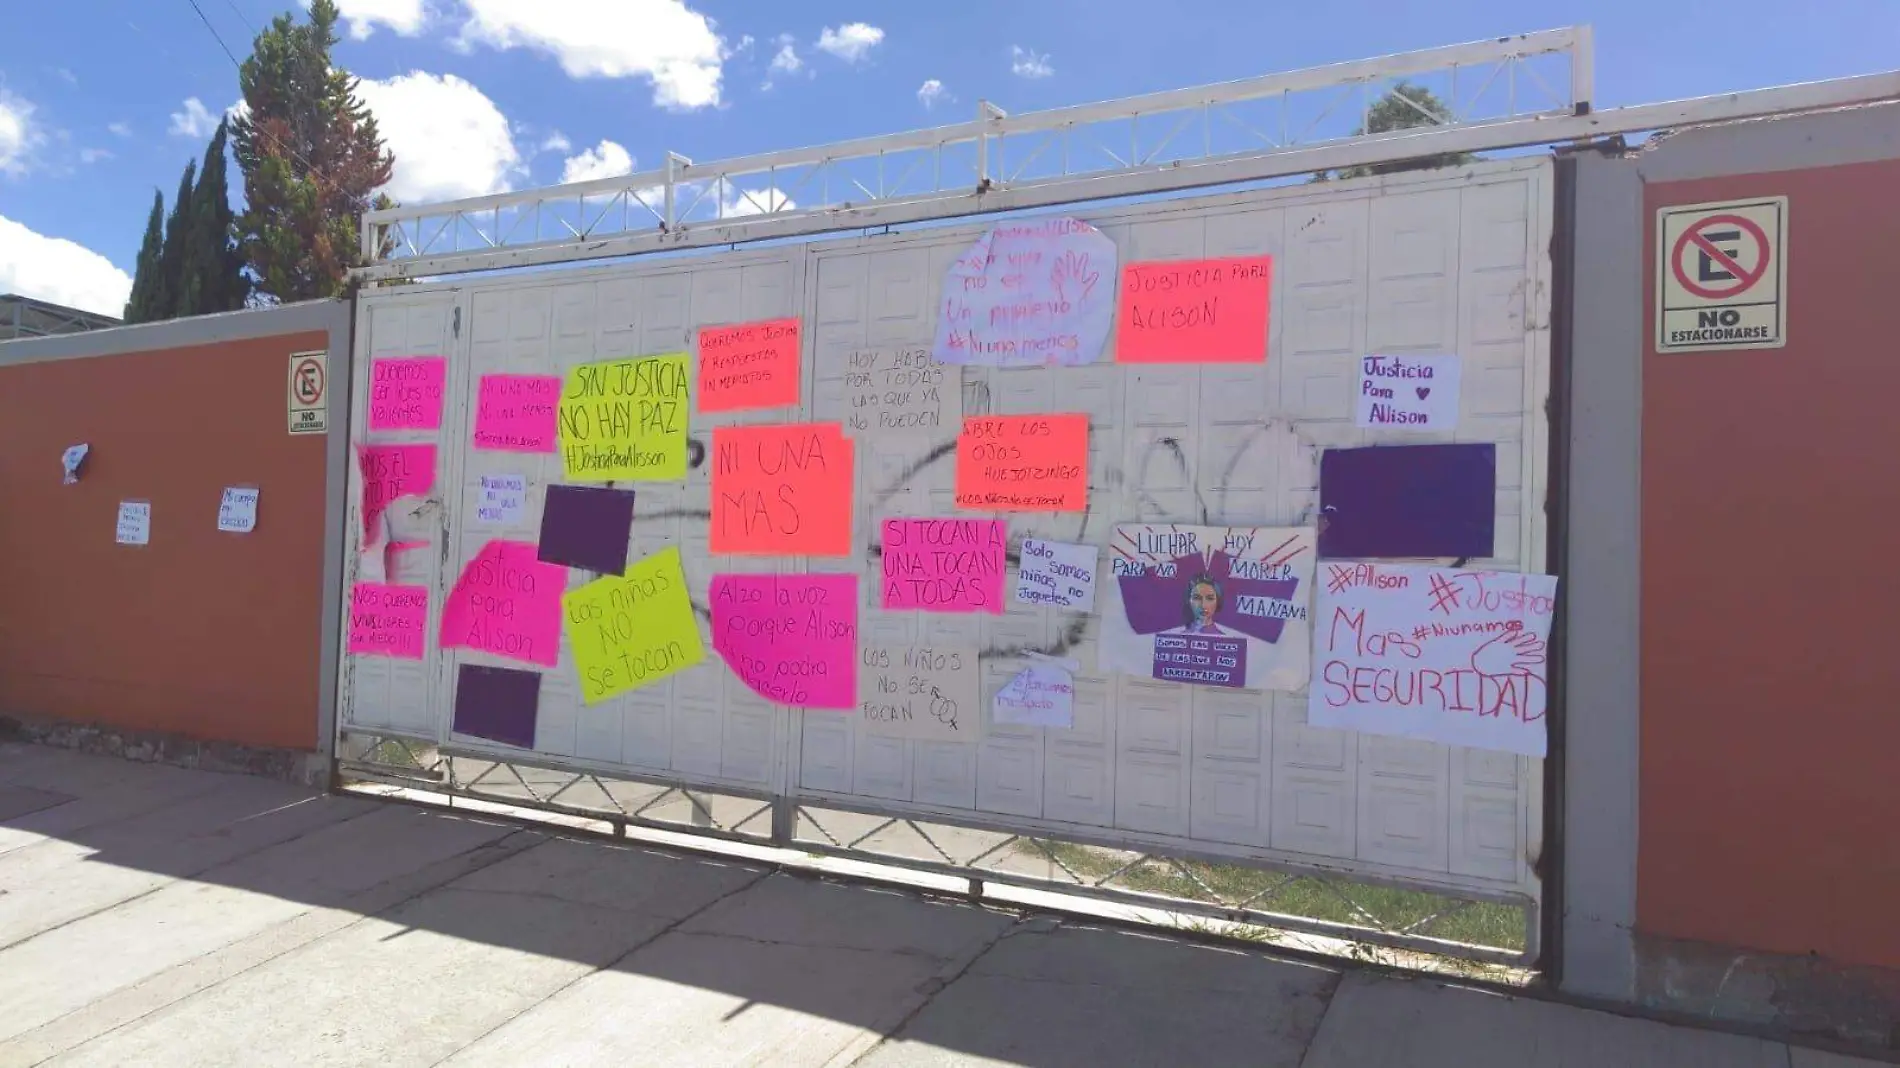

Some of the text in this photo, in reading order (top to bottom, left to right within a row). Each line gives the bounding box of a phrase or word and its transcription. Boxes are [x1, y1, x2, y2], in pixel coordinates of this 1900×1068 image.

[1128, 267, 1222, 293] JUSTICIA
[1699, 310, 1741, 328] NO
[1671, 326, 1768, 342] ESTACIONARSE
[849, 351, 880, 369] HOY
[1362, 356, 1434, 379] Justicia
[569, 359, 689, 399] SIN JUSTICIA
[846, 372, 875, 388] POR
[1362, 380, 1394, 399] Para
[301, 411, 317, 422] NO
[559, 405, 590, 440] NO
[597, 400, 630, 439] HAY
[637, 400, 679, 437] PAZ
[879, 411, 940, 428] PUEDEN
[1369, 402, 1429, 424] Allison
[1020, 422, 1051, 436] LOS
[720, 433, 827, 476] NI UNA
[972, 442, 1022, 461] OJOS
[722, 483, 800, 537] MAS
[886, 519, 1003, 548] SI TOCAN A
[1138, 532, 1255, 553] LUCHAR HOY
[931, 550, 999, 577] TOCAN
[1112, 558, 1292, 581] PARA NO MORIR
[719, 579, 763, 605] Alzo
[774, 573, 793, 608] la
[1068, 585, 1085, 598] no
[1328, 563, 1409, 595] #Allison
[888, 581, 902, 606] A
[598, 611, 633, 655] NO
[804, 609, 856, 641] Alison
[1330, 606, 1421, 658] Mas
[466, 617, 533, 660] Alison
[863, 646, 963, 672] LOS NIÑOS
[1324, 660, 1547, 723] SEGURIDAD
[862, 699, 915, 722] TOCAN
